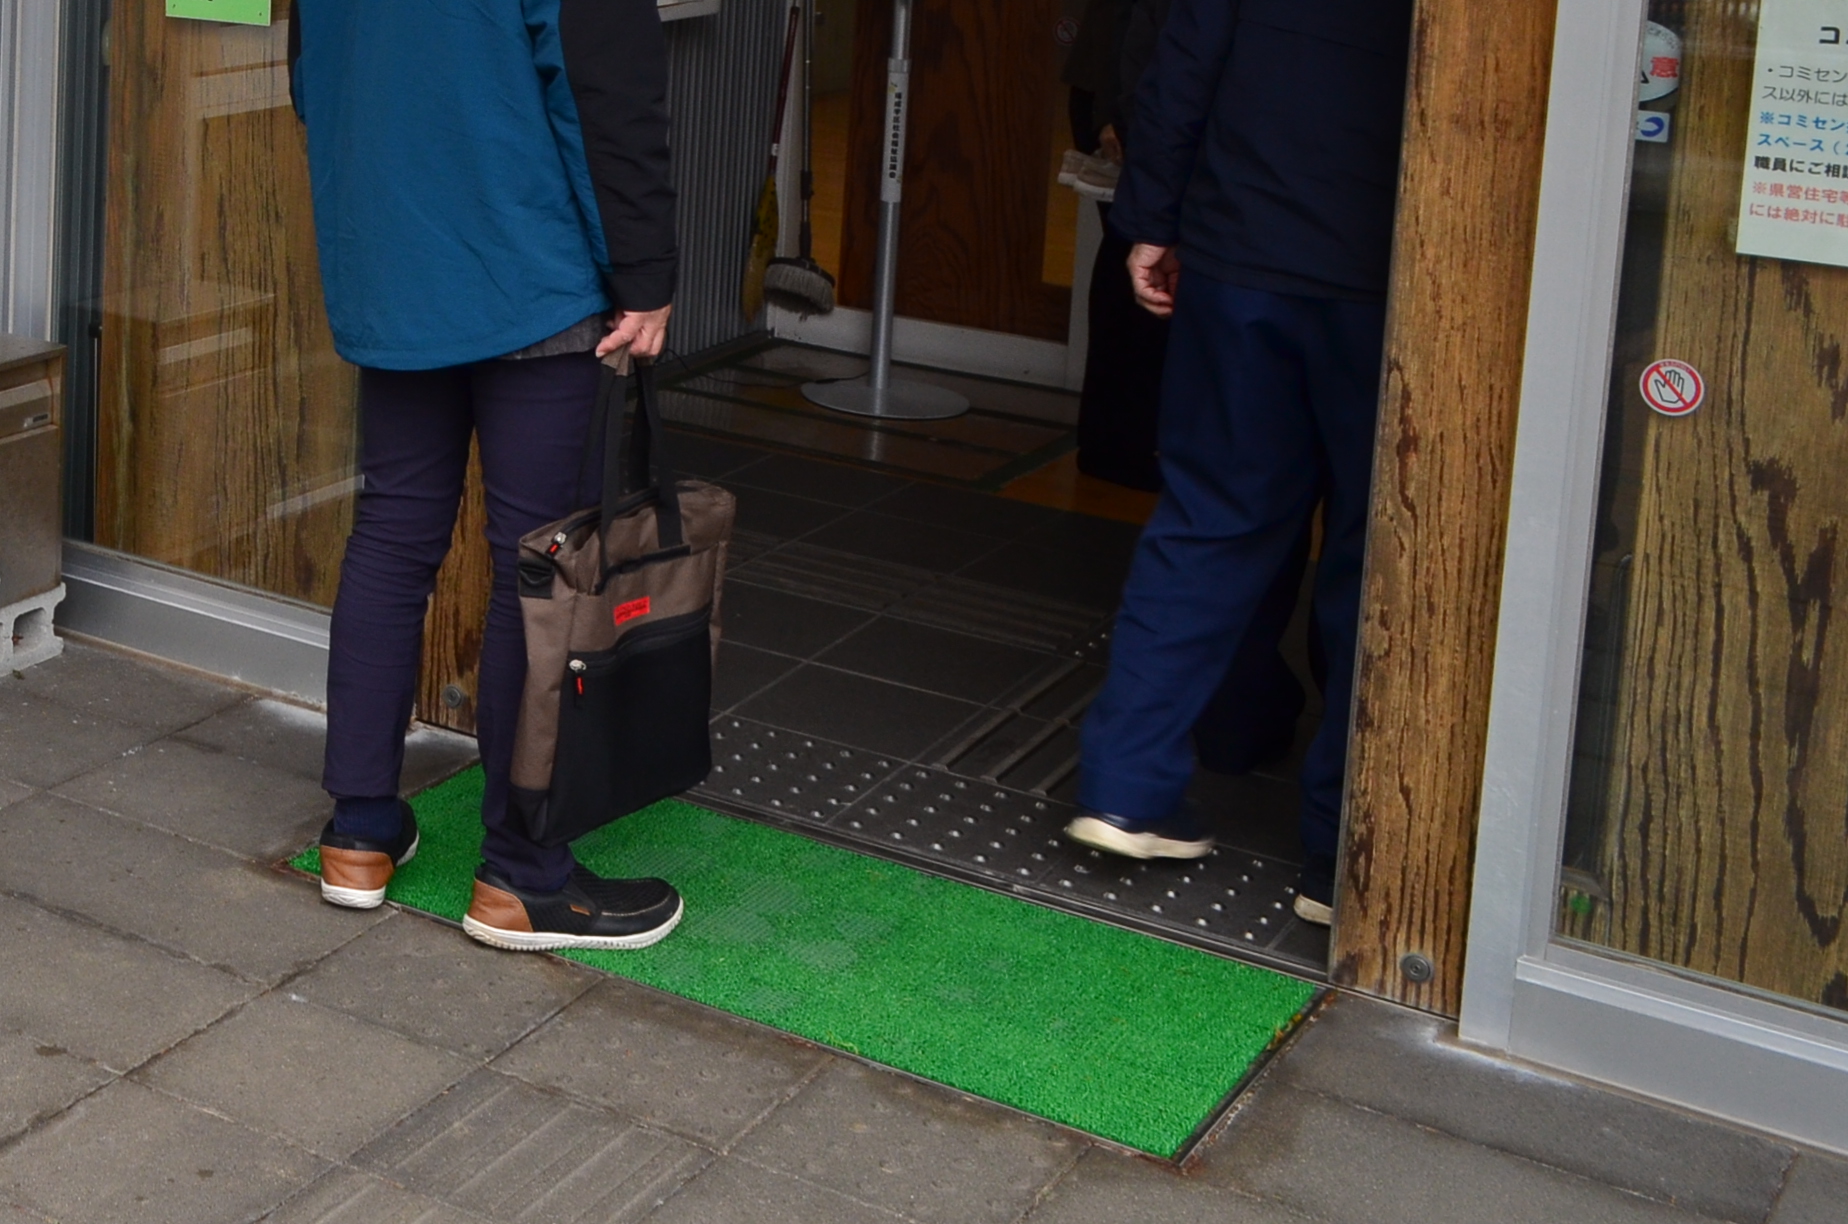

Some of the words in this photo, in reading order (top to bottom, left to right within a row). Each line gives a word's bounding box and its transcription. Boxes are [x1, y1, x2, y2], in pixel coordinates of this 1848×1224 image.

[1819, 26, 1848, 45] コ
[1760, 111, 1848, 133] ※コミセン
